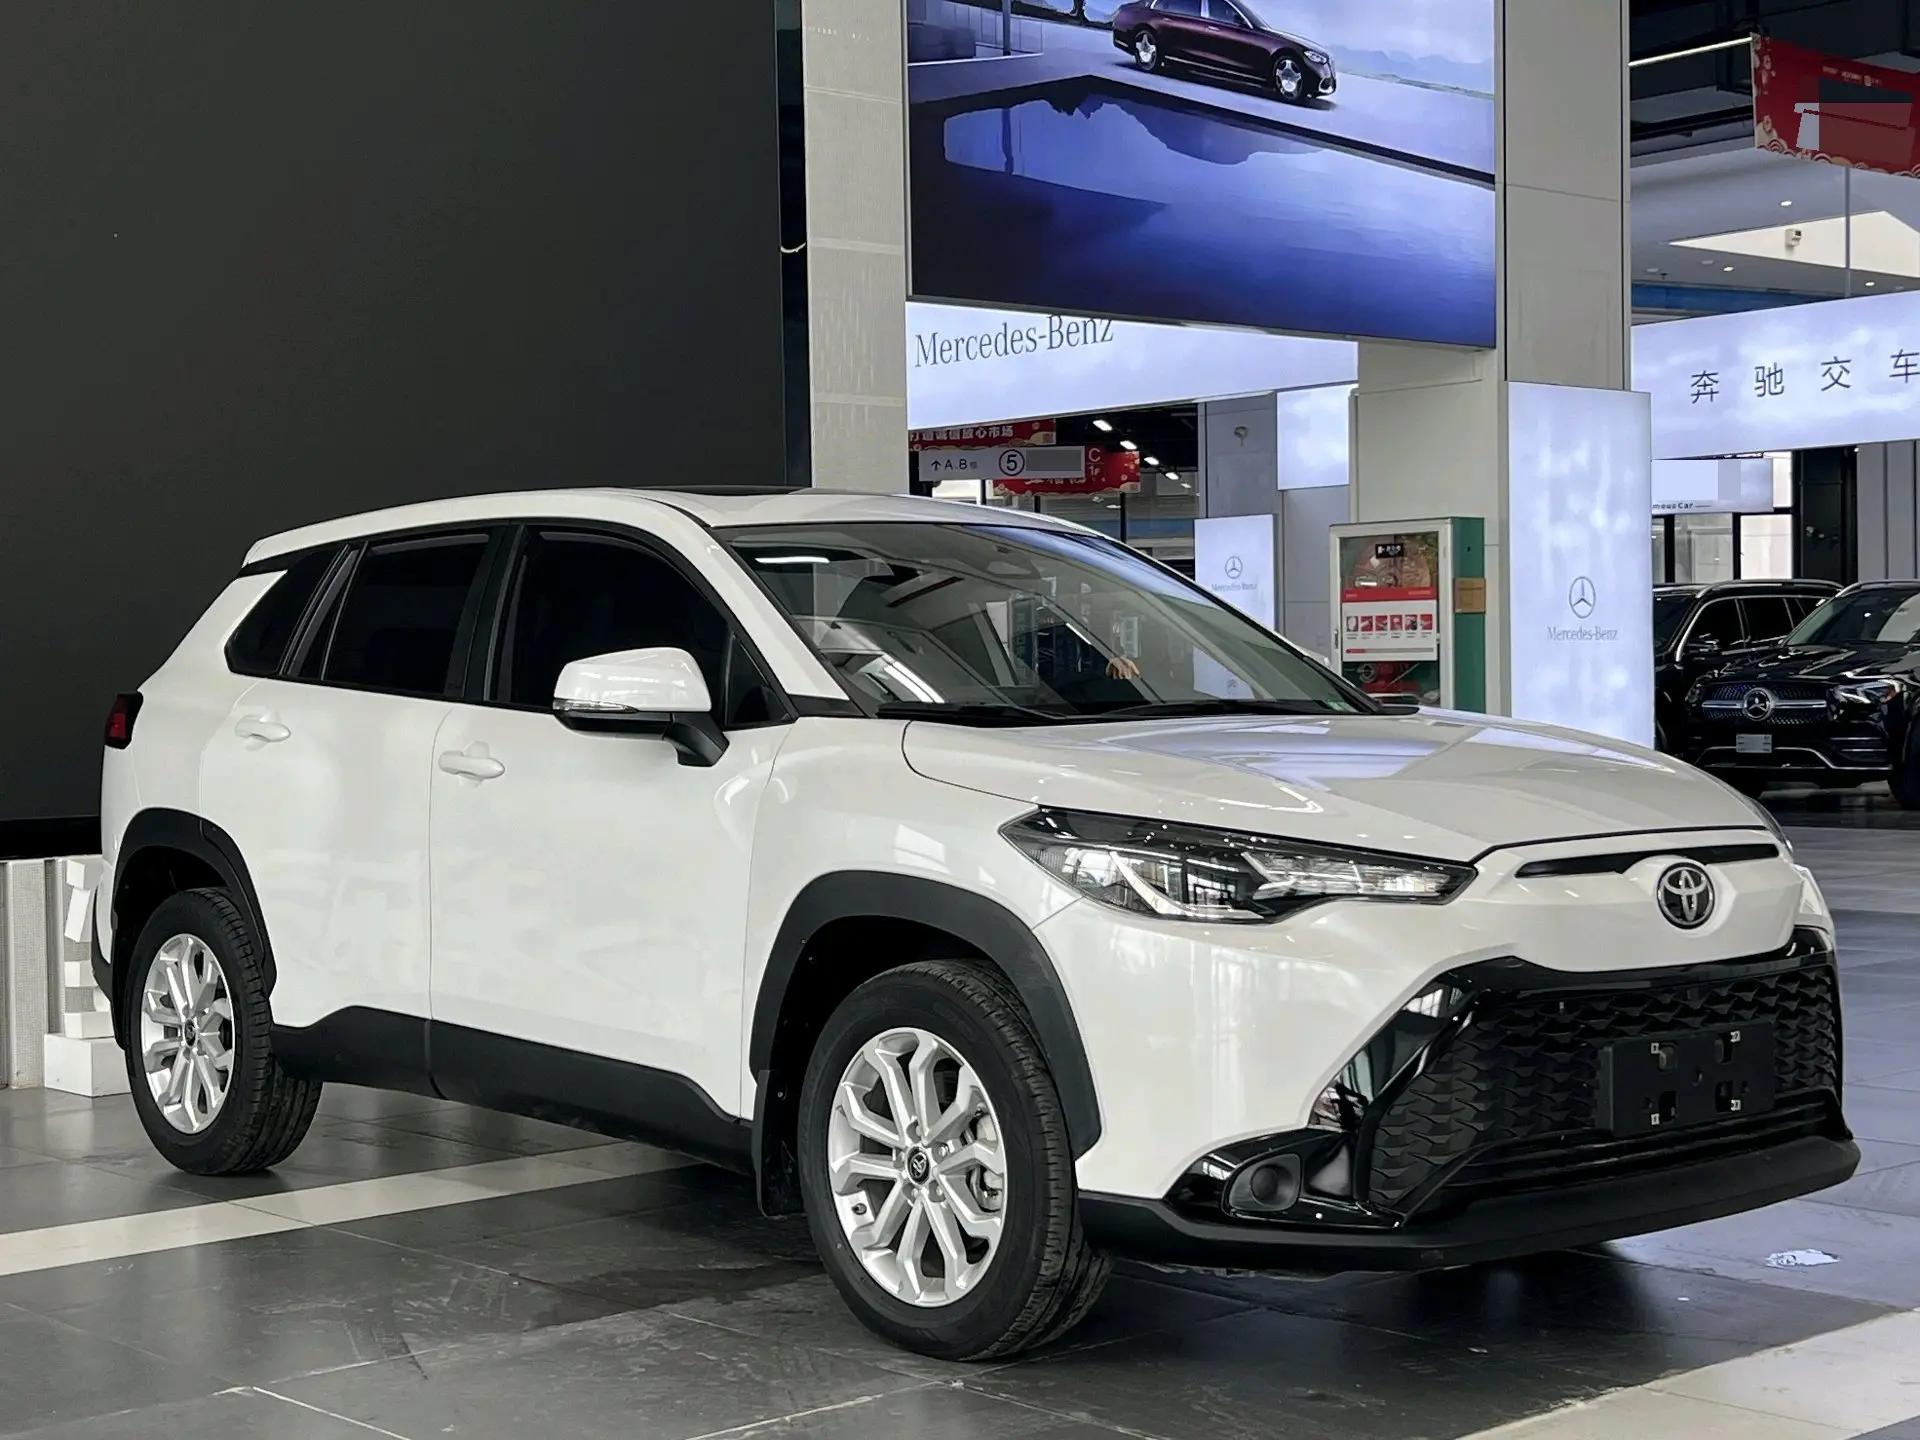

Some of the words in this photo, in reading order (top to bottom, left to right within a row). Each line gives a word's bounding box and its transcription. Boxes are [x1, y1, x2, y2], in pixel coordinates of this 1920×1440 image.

[914, 314, 1114, 368] Mercedes-Benz
[1690, 348, 1920, 405] 奔驰交车
[1087, 447, 1101, 462] C
[1547, 625, 1618, 641] Mercedes-Benz
